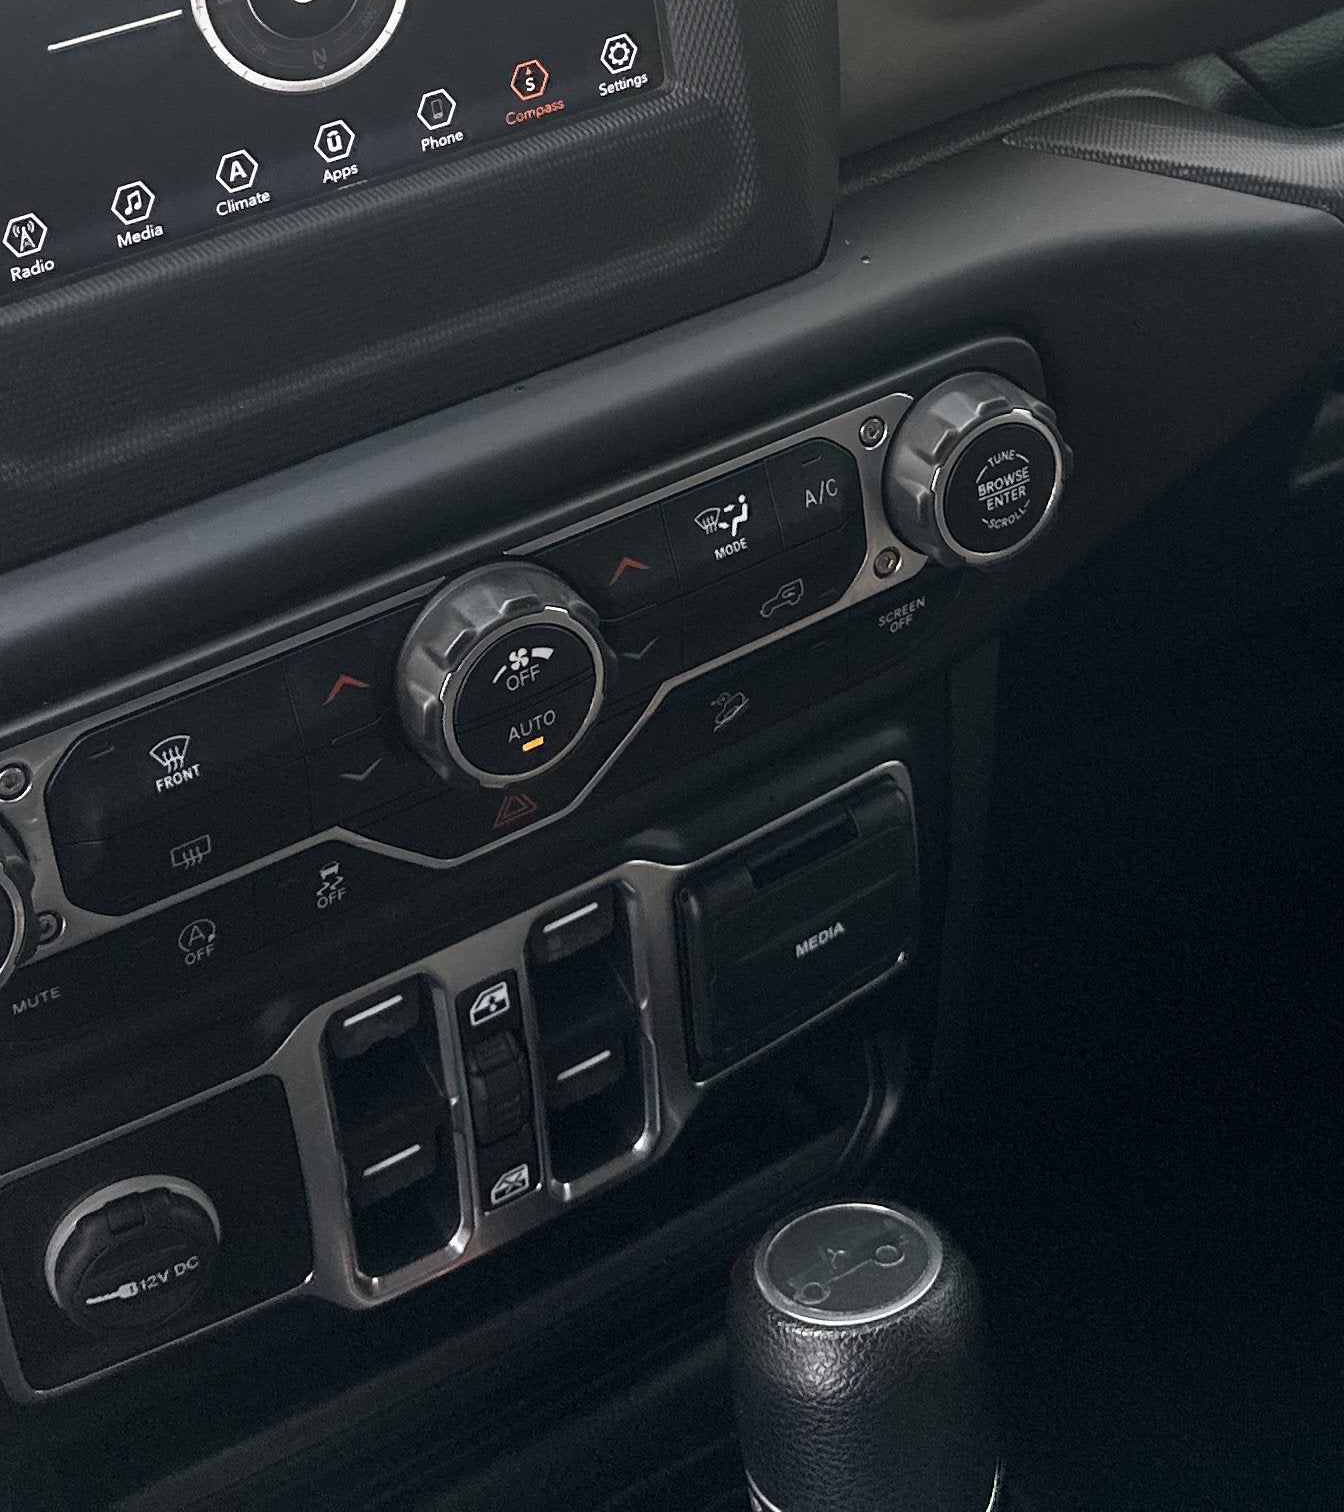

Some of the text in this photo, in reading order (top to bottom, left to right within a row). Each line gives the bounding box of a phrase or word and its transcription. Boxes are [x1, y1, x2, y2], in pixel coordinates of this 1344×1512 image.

[598, 72, 649, 98] Settings
[505, 97, 566, 127] Compass
[419, 128, 465, 152] Phone
[322, 161, 360, 186] Apps
[215, 188, 272, 216] Climate
[116, 224, 165, 249] Media
[9, 258, 55, 282] Radio
[987, 449, 1016, 467] TUNE
[977, 465, 1030, 495] BROWSE
[804, 478, 839, 509] A/C
[985, 484, 1027, 510] ENTER
[987, 506, 1027, 529] SCROLL
[713, 536, 749, 561] MODE
[877, 596, 926, 627] SCREEN
[889, 614, 914, 634] OFF
[506, 665, 541, 692] OFF
[508, 709, 557, 743] AUTO
[156, 763, 201, 791] FRONT
[316, 889, 347, 910] OFF
[795, 921, 845, 959] MEDIA
[184, 944, 216, 965] OFF
[11, 986, 62, 1016] MUTE
[138, 1255, 200, 1291] 12V DC
